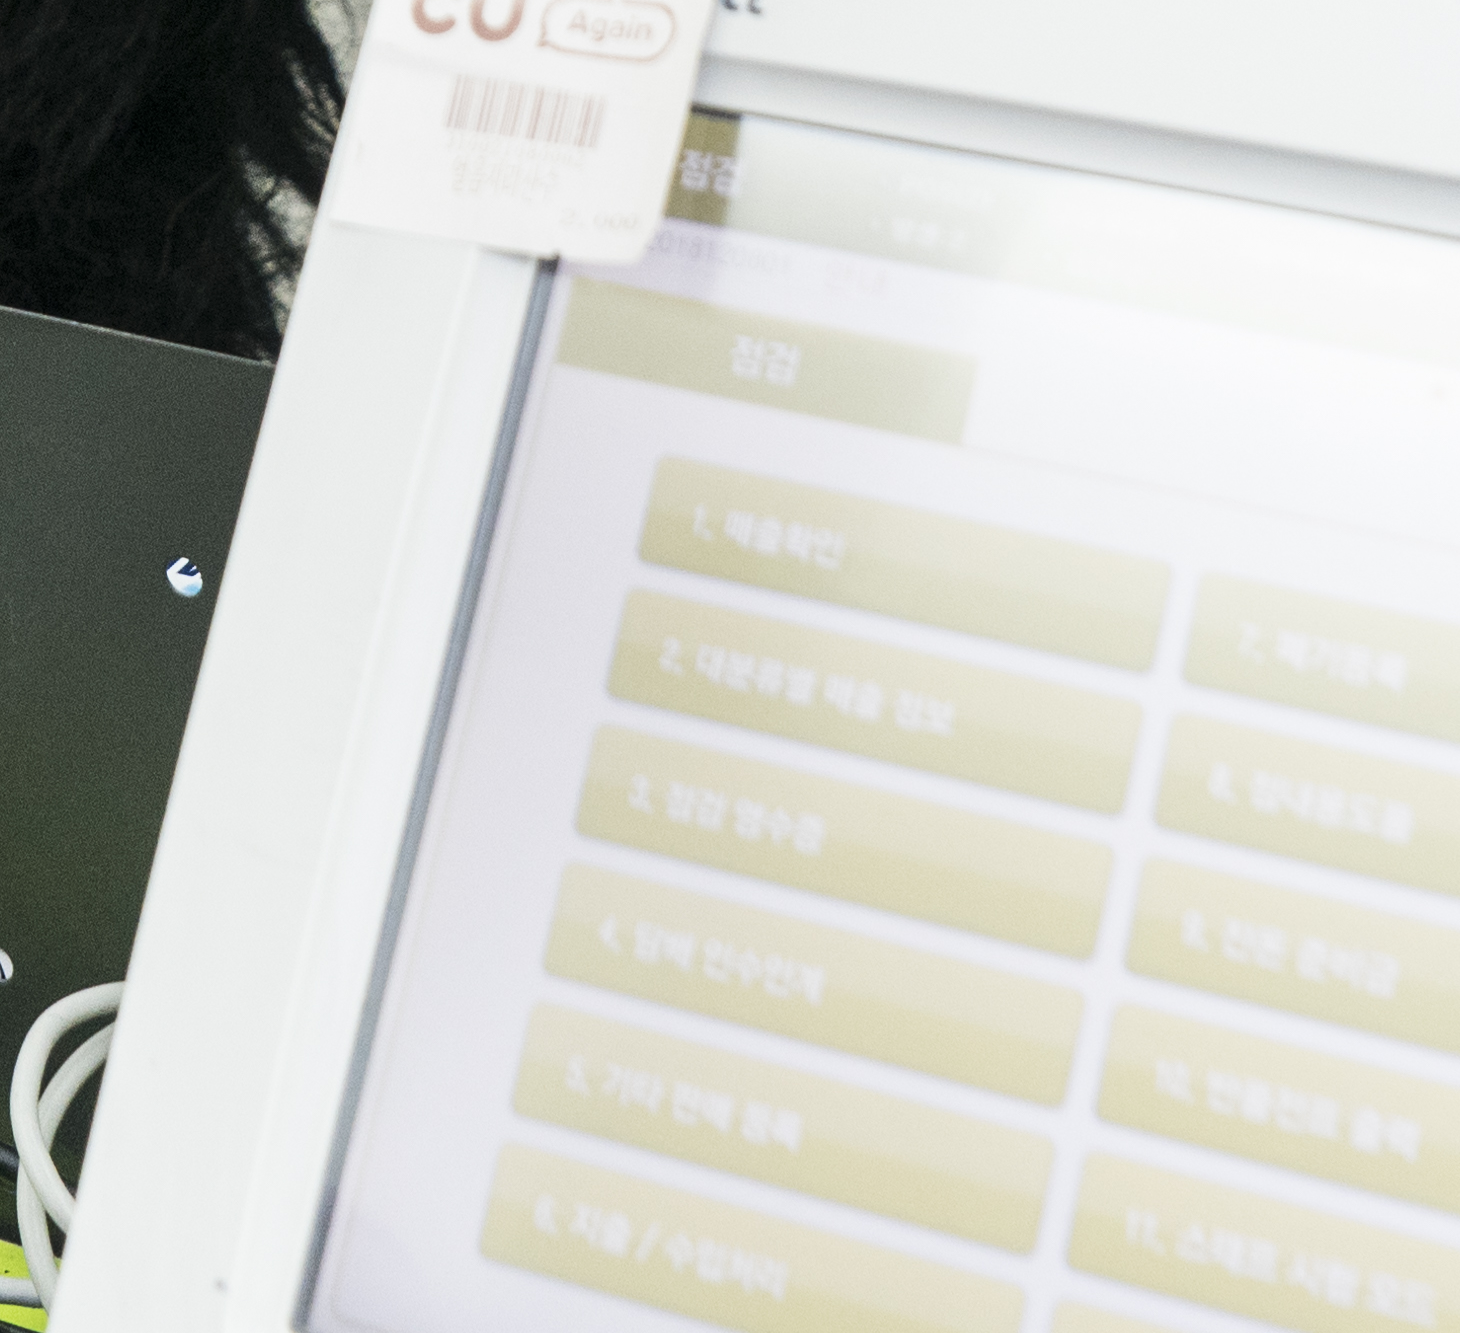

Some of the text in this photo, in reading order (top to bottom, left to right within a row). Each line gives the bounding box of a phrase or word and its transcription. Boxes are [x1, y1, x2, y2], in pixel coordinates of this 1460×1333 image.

[566, 8, 654, 43] Again
[730, 333, 802, 386] 점검
[600, 1061, 666, 1114] 기타
